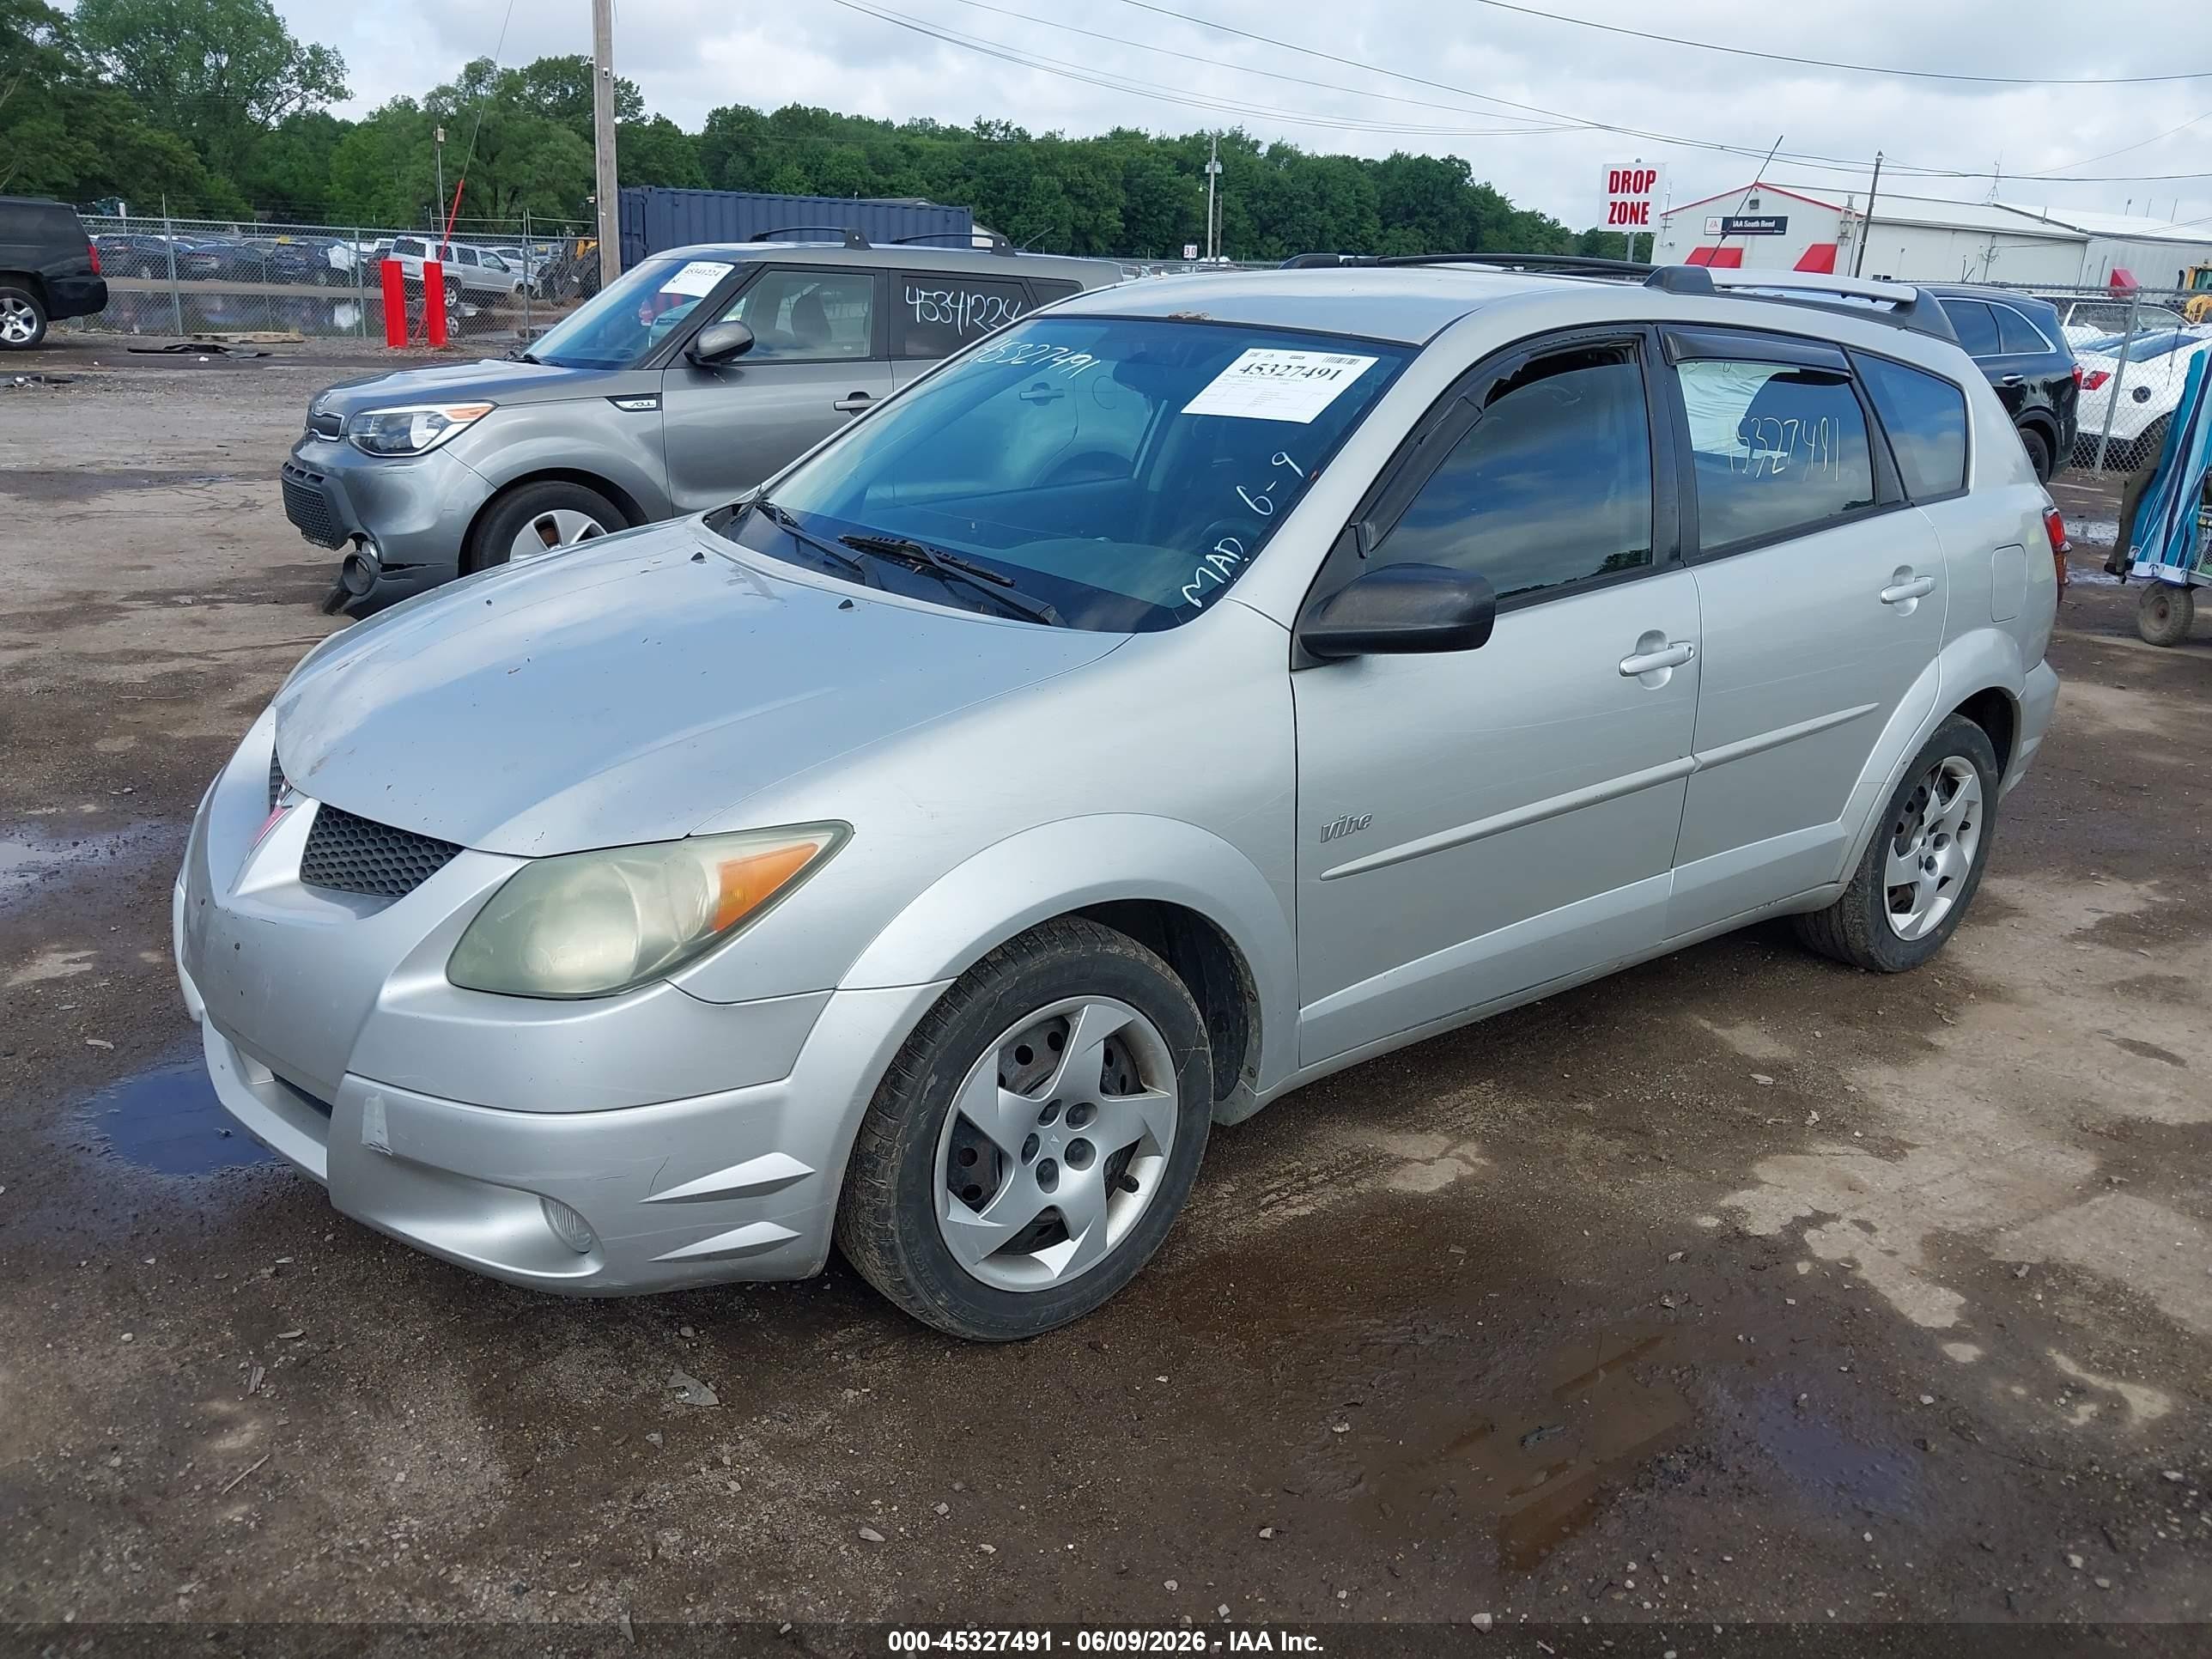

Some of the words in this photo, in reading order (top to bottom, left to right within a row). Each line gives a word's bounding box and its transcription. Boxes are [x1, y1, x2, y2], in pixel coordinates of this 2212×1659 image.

[1608, 170, 1657, 194] DROP
[1607, 201, 1650, 225] ZONE
[1743, 219, 1760, 228] South
[1184, 246, 1197, 257] 30
[905, 286, 1021, 337] 45341224
[1238, 362, 1344, 381] 45327491
